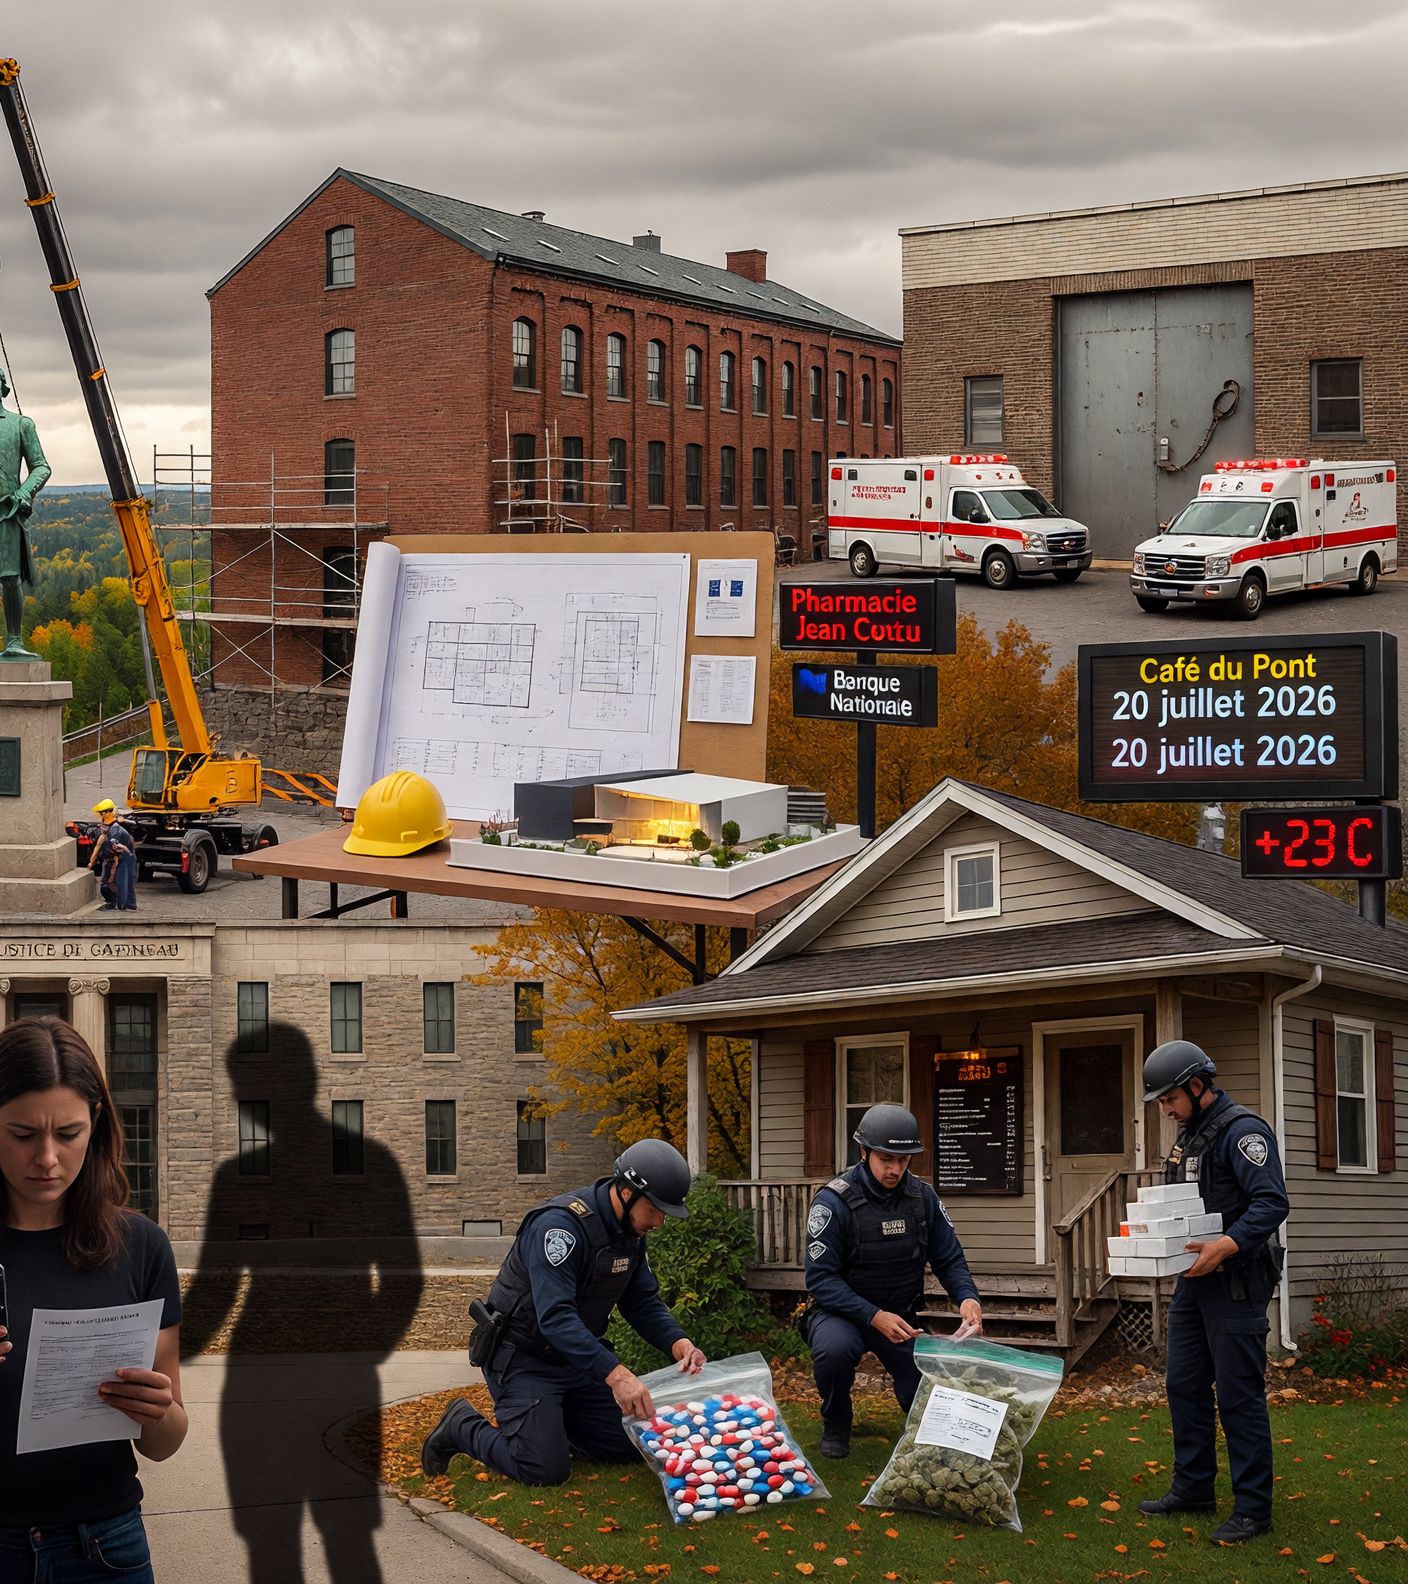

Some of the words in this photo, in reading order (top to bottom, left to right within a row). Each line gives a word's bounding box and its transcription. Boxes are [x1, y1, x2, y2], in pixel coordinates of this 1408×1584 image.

[792, 588, 917, 613] Pharmacie
[795, 615, 846, 641] Jean
[1139, 656, 1200, 684] Café
[1209, 655, 1242, 680] du
[1253, 653, 1317, 679] Pont
[834, 670, 901, 696] Banque
[1112, 690, 1149, 720] 20
[1158, 687, 1245, 728] juillet
[1257, 685, 1337, 718] 2026
[1111, 738, 1148, 768] 20
[1157, 736, 1245, 775] juillet
[1256, 734, 1337, 766] 2026
